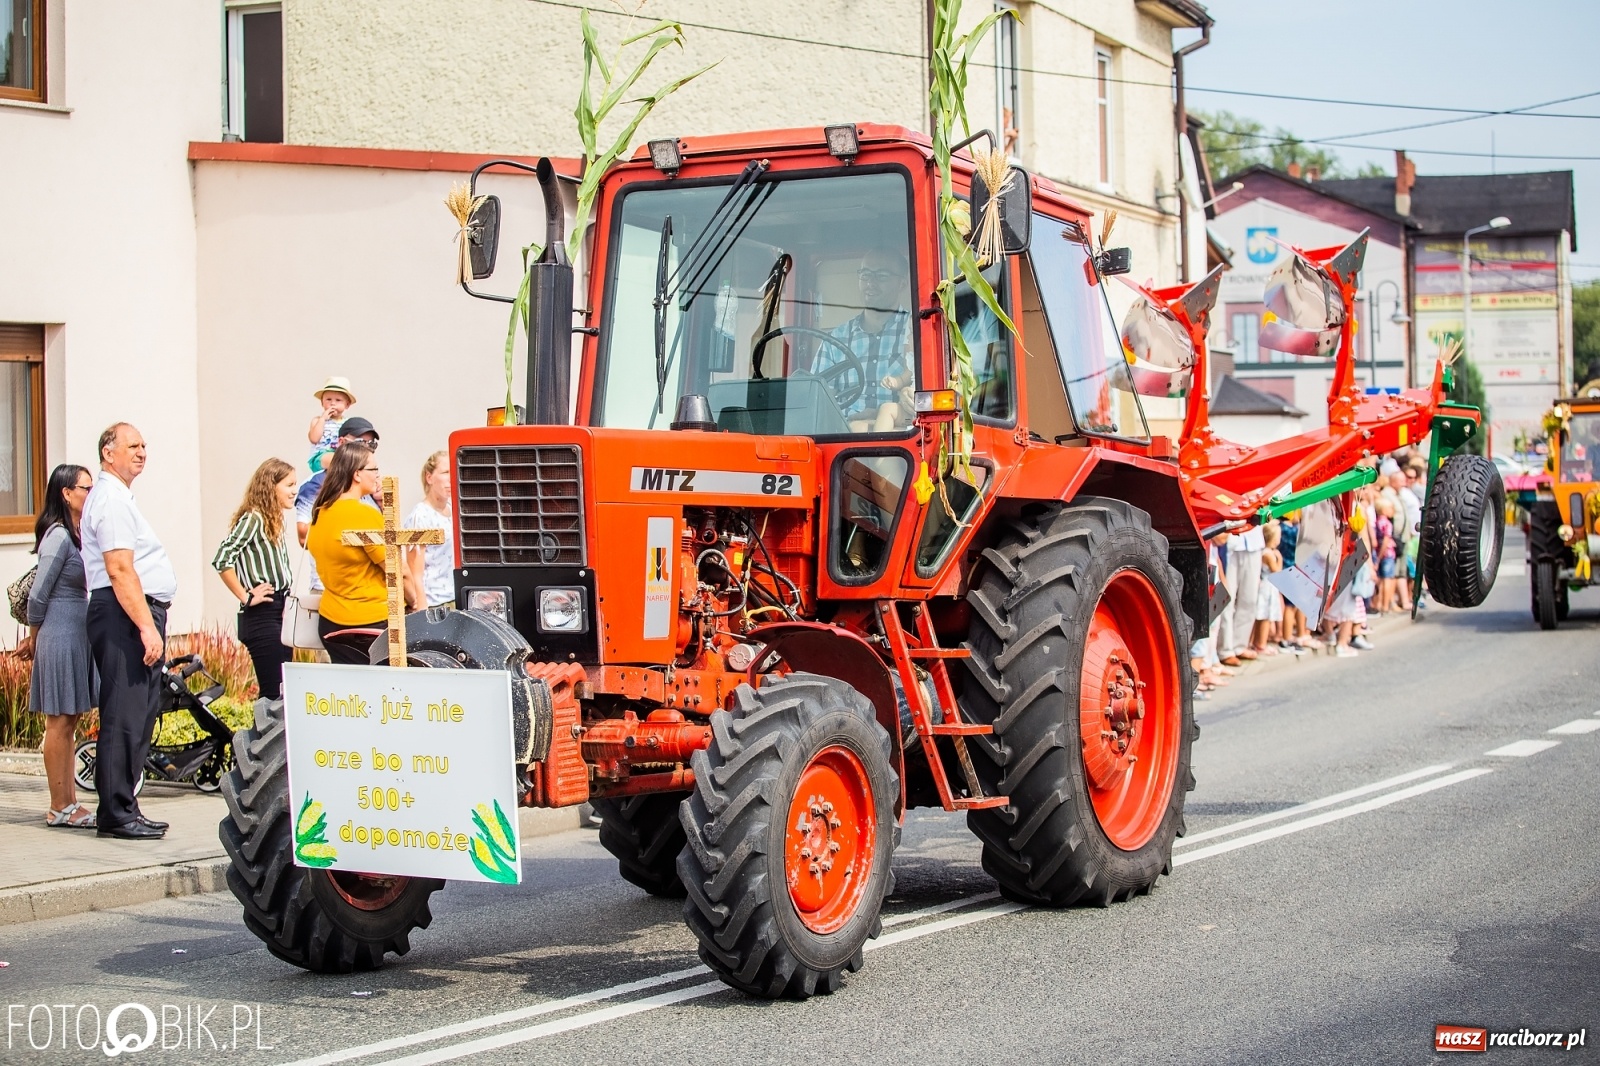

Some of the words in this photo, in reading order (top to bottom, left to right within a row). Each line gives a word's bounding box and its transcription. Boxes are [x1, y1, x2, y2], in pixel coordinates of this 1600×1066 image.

[641, 468, 696, 491] MTZ
[761, 474, 793, 495] 82
[305, 692, 368, 718] Rolnik
[381, 694, 413, 724] już
[427, 699, 464, 722] nie
[314, 749, 362, 769] orze
[372, 747, 402, 771] bo
[412, 754, 449, 774] mu
[357, 786, 415, 811] 500+
[339, 819, 470, 851] dopomoże
